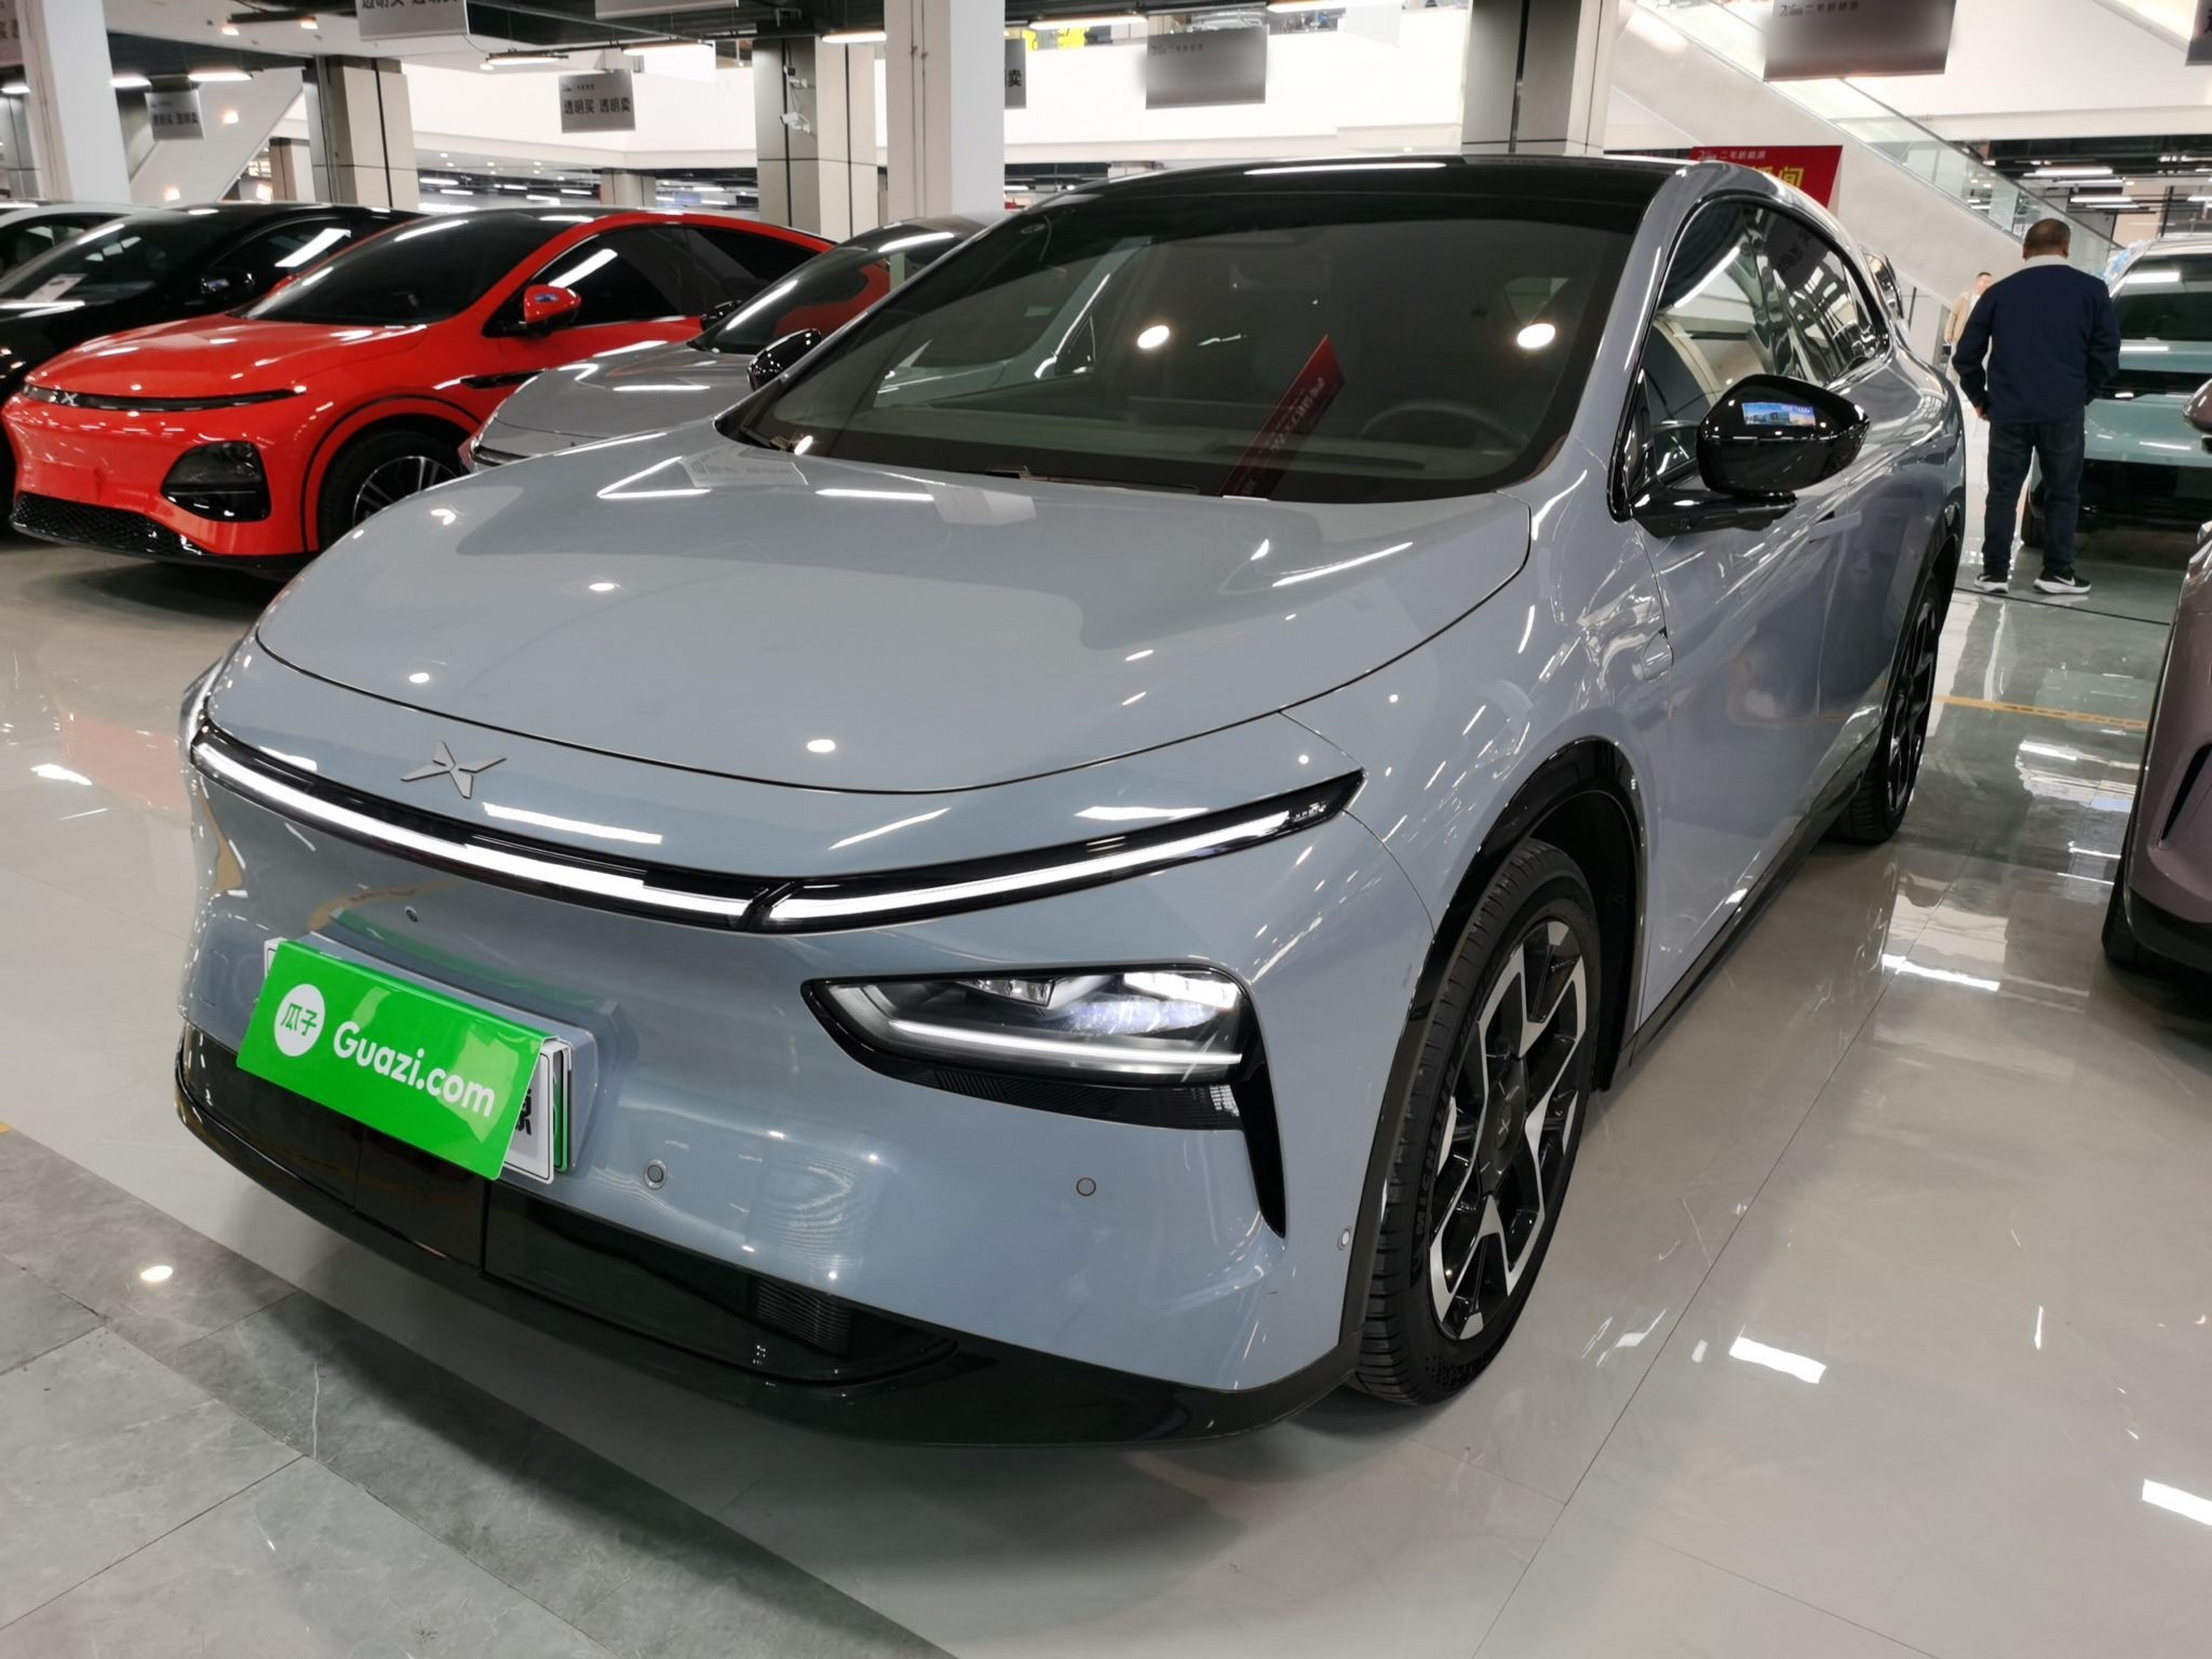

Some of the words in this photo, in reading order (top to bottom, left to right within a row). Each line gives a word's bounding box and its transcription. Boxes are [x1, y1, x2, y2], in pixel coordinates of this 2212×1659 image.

[1005, 69, 1022, 87] 卖
[281, 1002, 317, 1036] 瓜子
[334, 1021, 495, 1117] Guazi.com
[1415, 1062, 1457, 1238] MICHELIN
